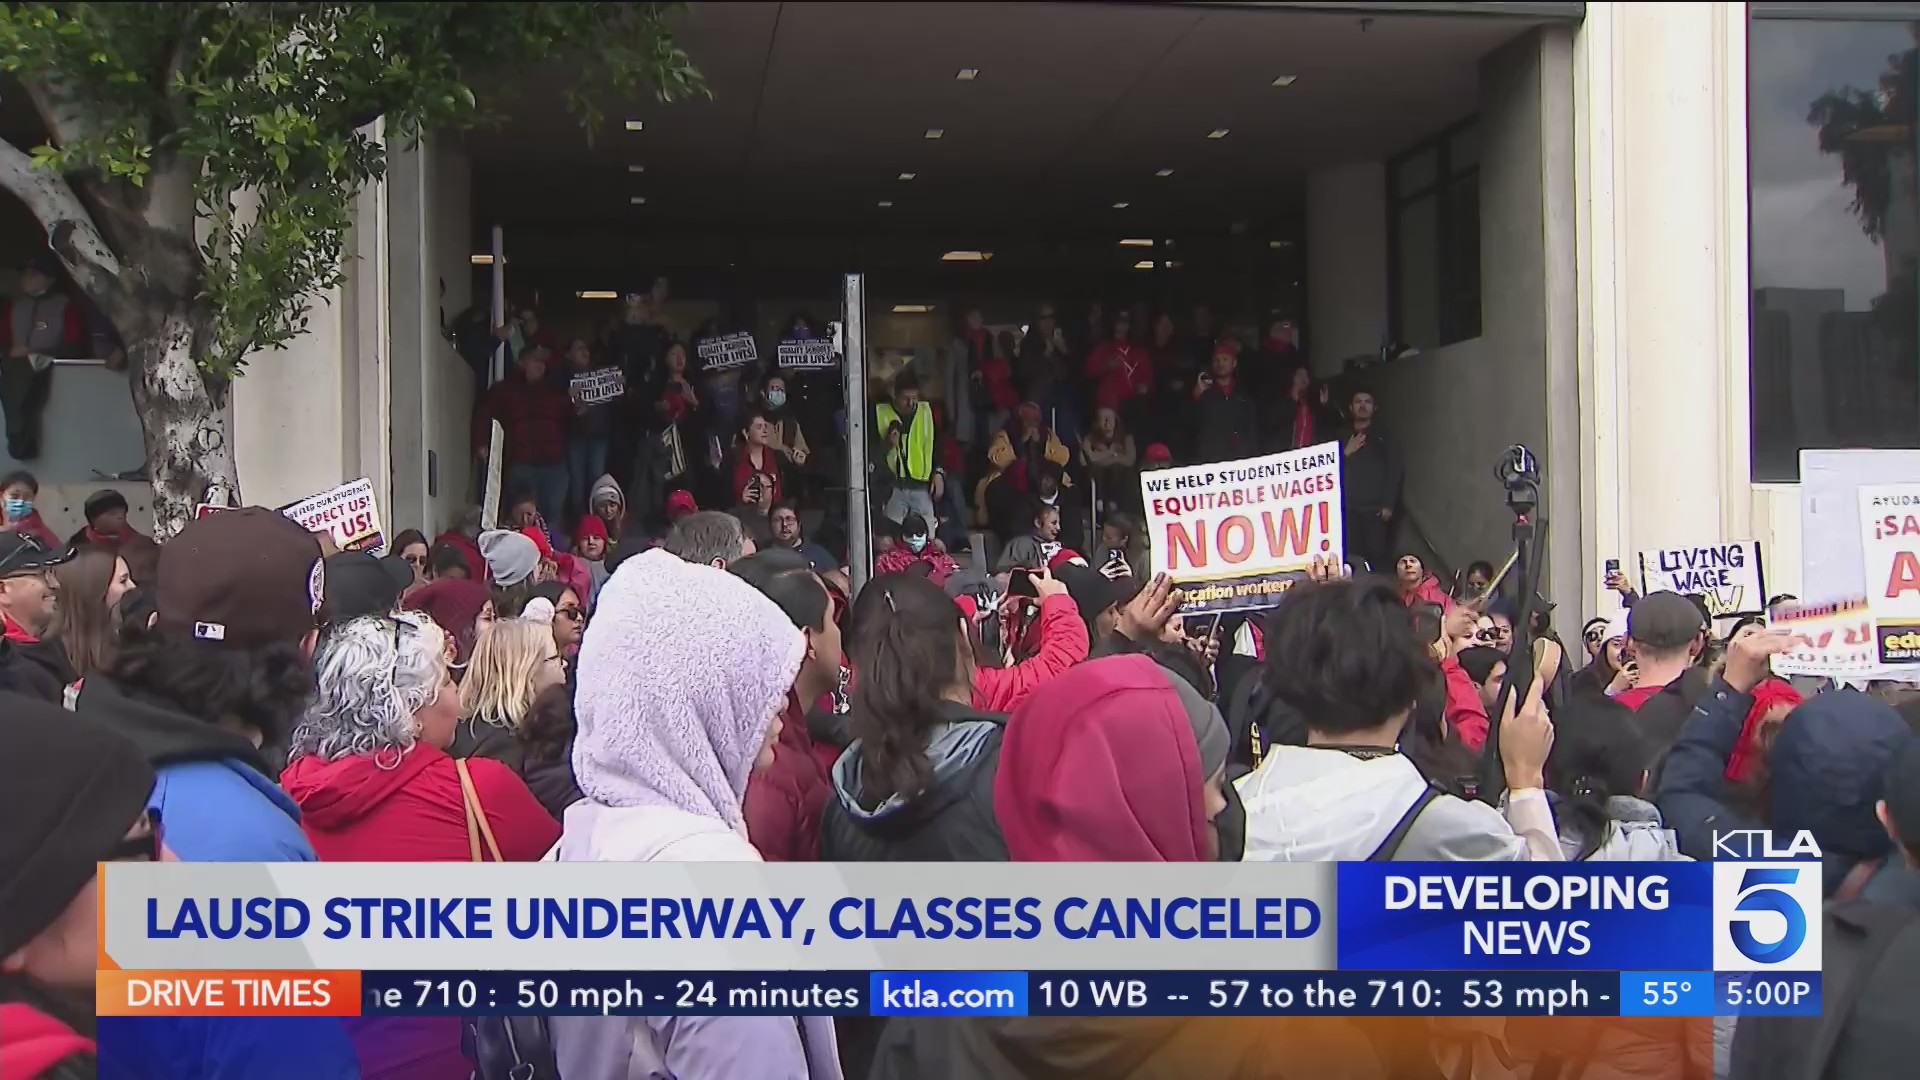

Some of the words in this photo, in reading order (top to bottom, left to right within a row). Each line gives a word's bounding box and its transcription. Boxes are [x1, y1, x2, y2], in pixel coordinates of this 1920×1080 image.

[1146, 478, 1171, 492] WE
[1176, 473, 1215, 489] HELP
[1220, 461, 1290, 484] STUDENTS
[1294, 452, 1335, 472] LEARN
[302, 503, 344, 528] ESPECT
[348, 495, 370, 512] US!
[1153, 486, 1265, 516] EQUITABLE
[1272, 474, 1334, 500] WAGES
[341, 511, 372, 537] US!
[1166, 501, 1331, 570] NOW!
[1659, 544, 1745, 572] LIVING
[1672, 569, 1732, 592] WAGE
